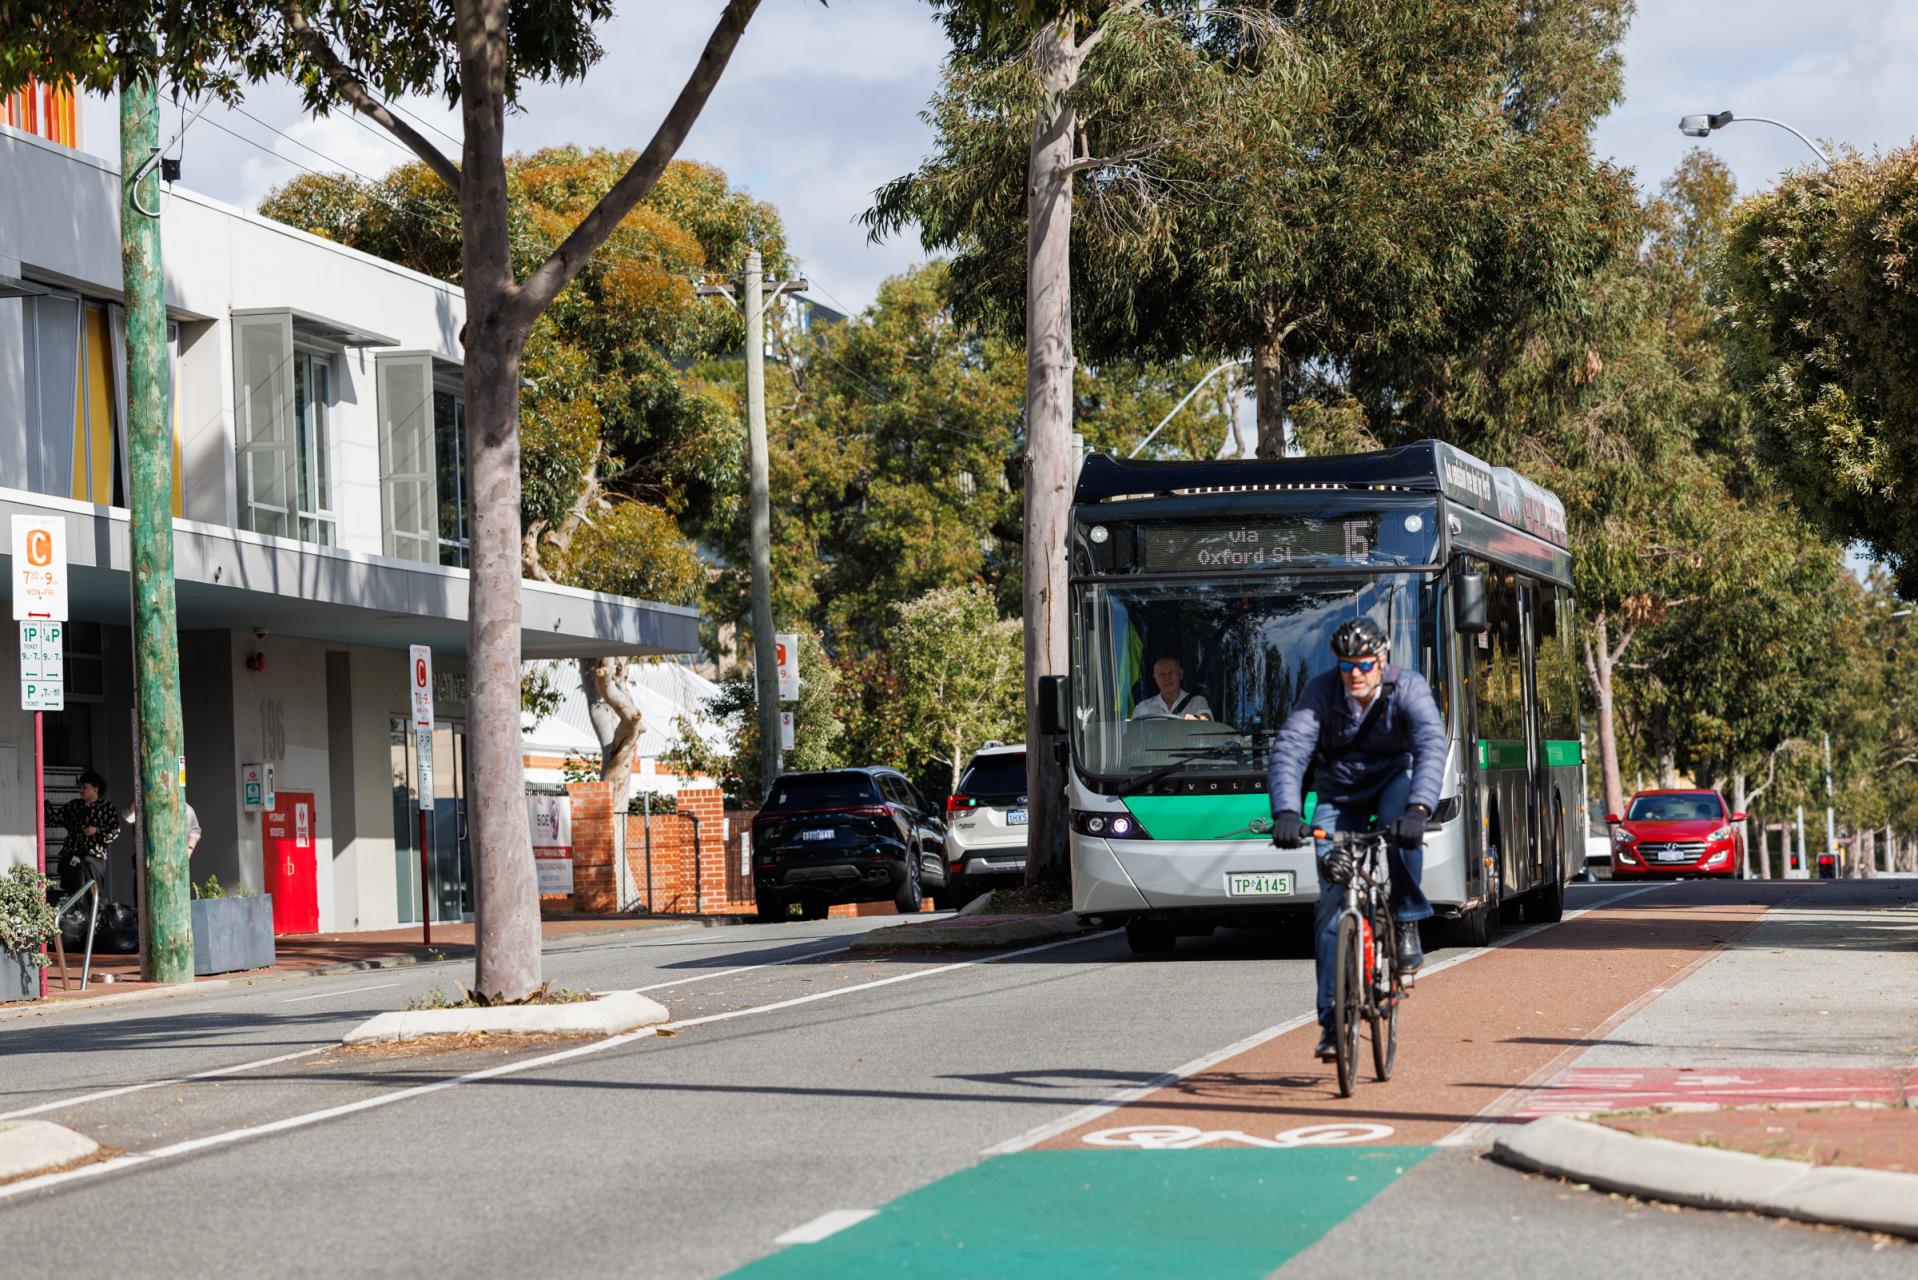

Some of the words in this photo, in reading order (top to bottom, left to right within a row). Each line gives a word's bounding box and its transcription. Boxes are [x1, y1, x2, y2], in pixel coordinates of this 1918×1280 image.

[32, 532, 47, 564] C
[1229, 526, 1259, 543] via
[1343, 520, 1370, 564] 15
[1197, 547, 1264, 565] Oxford
[1272, 546, 1293, 563] St
[23, 627, 37, 642] 1P
[27, 684, 36, 699] P
